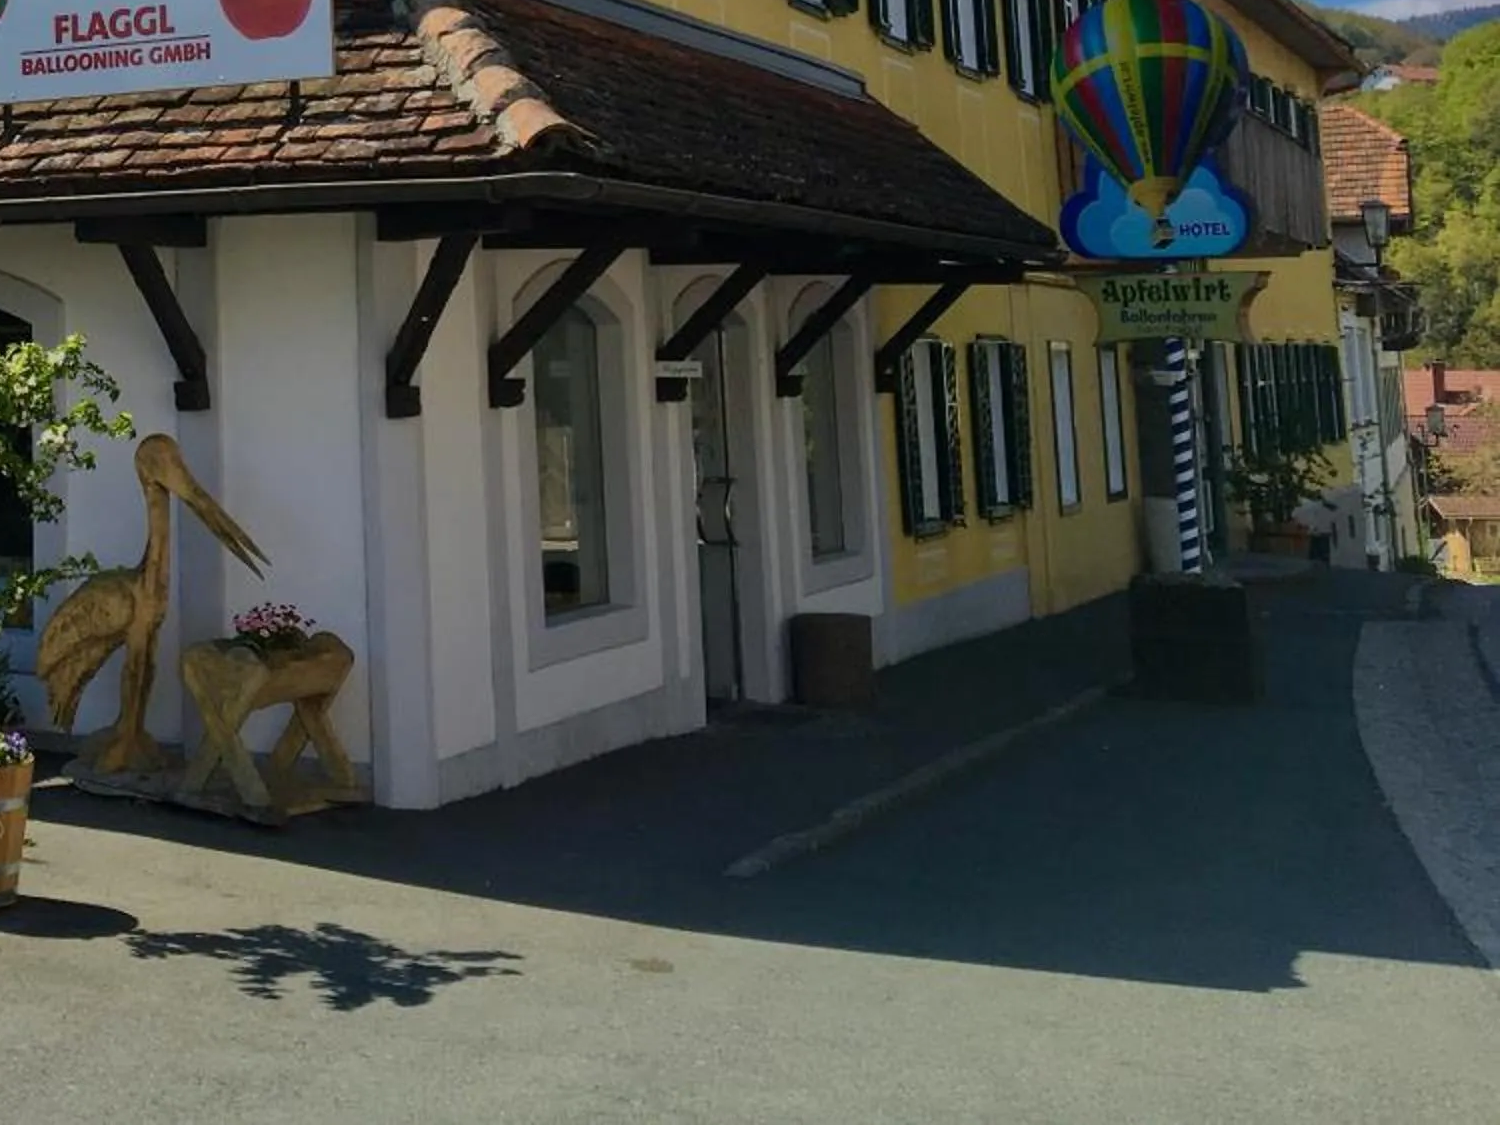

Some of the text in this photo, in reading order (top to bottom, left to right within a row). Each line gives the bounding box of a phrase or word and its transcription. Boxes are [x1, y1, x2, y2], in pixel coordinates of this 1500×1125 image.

[53, 4, 175, 44] FLAGGL
[20, 41, 211, 76] BALLOONING GMBH
[1179, 222, 1231, 238] HOTEL
[1102, 278, 1231, 308] Apfelwirt
